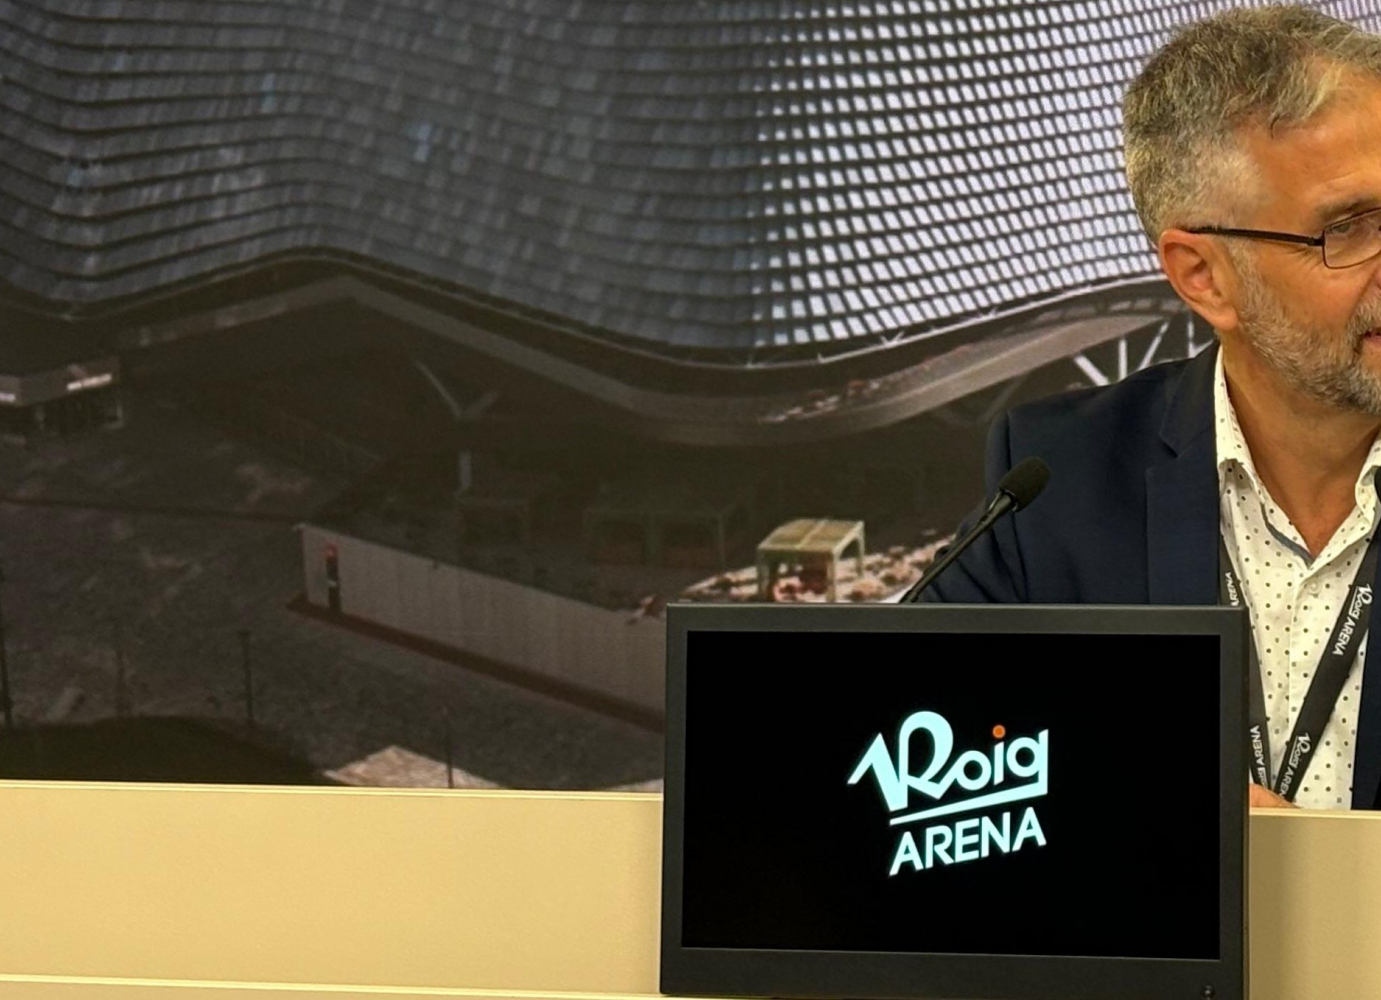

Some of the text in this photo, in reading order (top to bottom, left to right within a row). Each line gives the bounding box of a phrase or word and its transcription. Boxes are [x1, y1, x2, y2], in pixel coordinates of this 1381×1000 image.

[1332, 583, 1373, 656] Roig ARENA
[847, 710, 1049, 826] Roig
[1249, 725, 1265, 766] ARENA
[1279, 732, 1311, 799] Roig AREN
[888, 806, 1048, 876] ARENA
